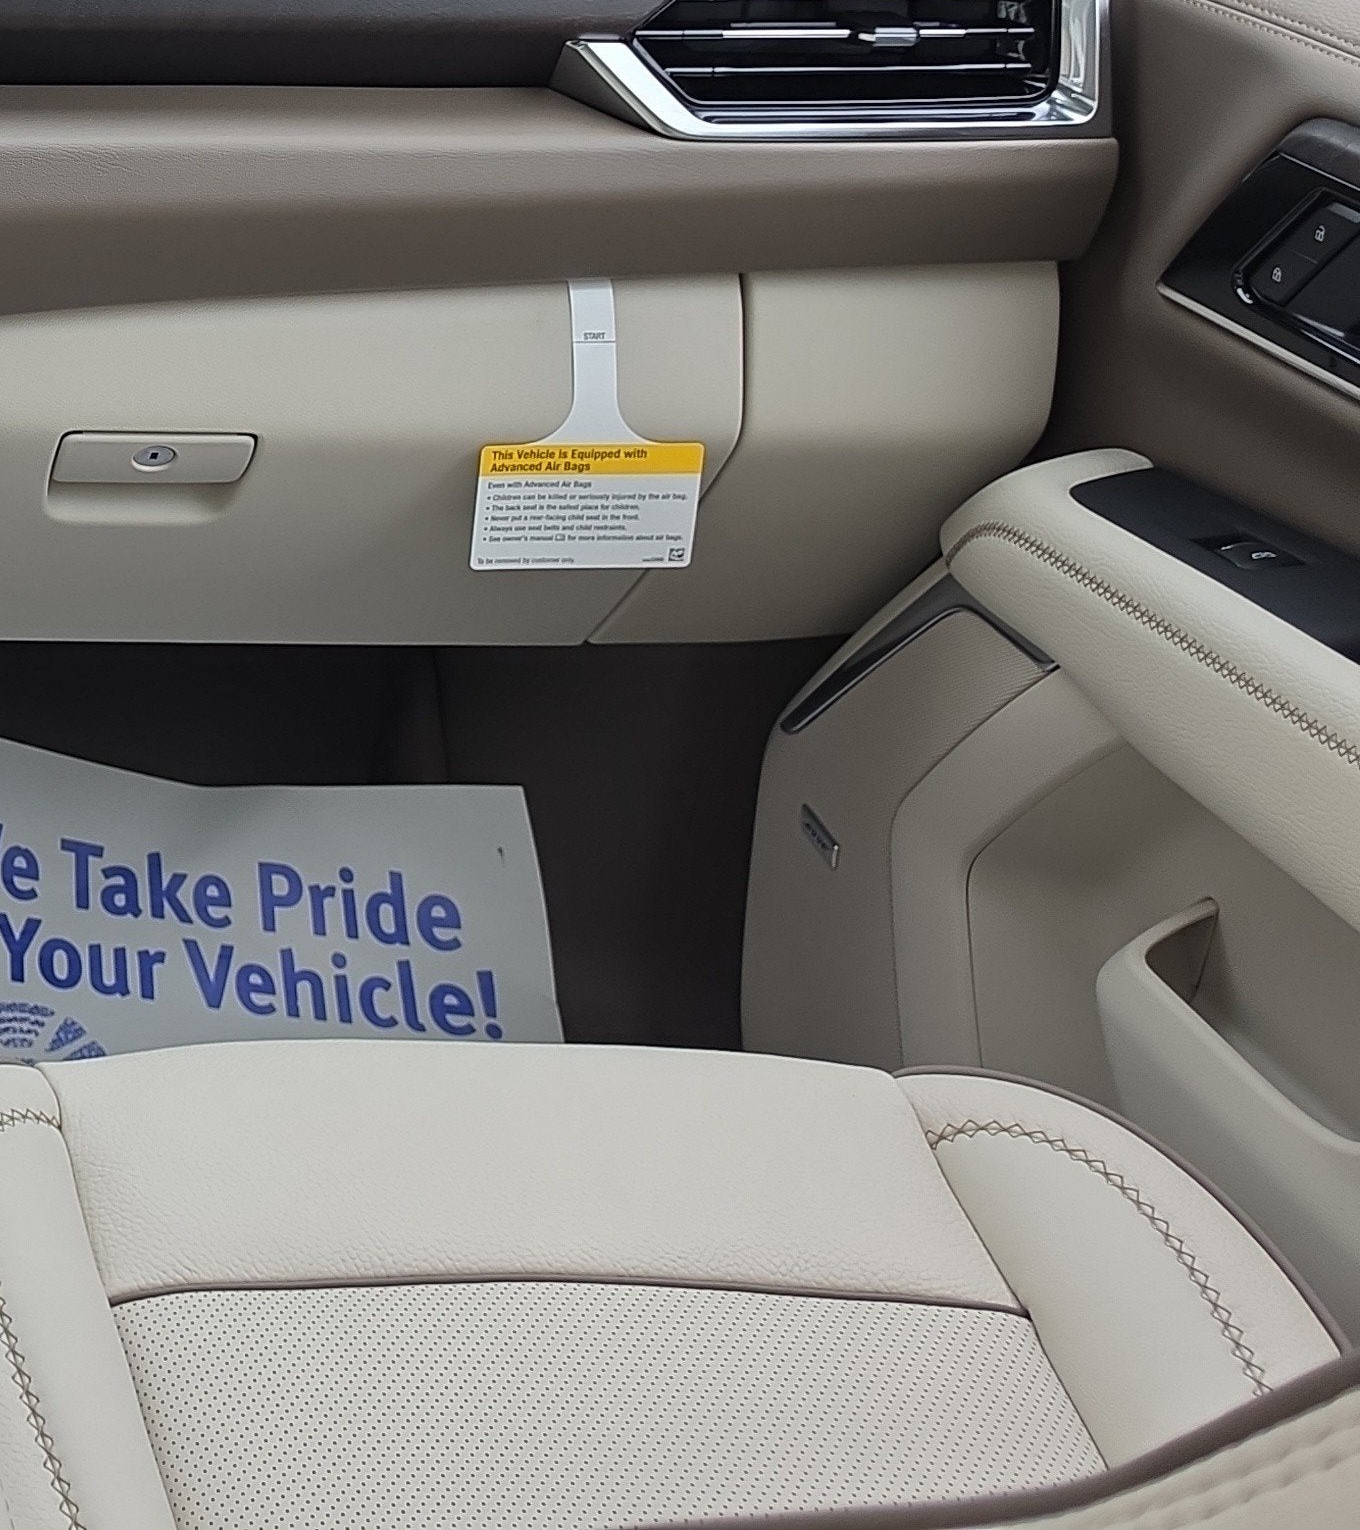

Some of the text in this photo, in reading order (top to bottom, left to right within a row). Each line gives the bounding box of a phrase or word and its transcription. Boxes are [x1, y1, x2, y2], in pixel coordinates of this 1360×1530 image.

[583, 331, 606, 340] START
[492, 450, 514, 460] This
[517, 449, 556, 460] Vehicle
[571, 449, 621, 461] Equipped
[624, 448, 648, 459] with
[490, 461, 591, 473] Advanced Air Bags
[524, 480, 559, 488] Advanced
[561, 480, 572, 488] Air
[573, 481, 592, 489] Bags
[60, 837, 233, 930] Take
[257, 860, 464, 952] Pride
[181, 937, 504, 1042] Vehicle!
